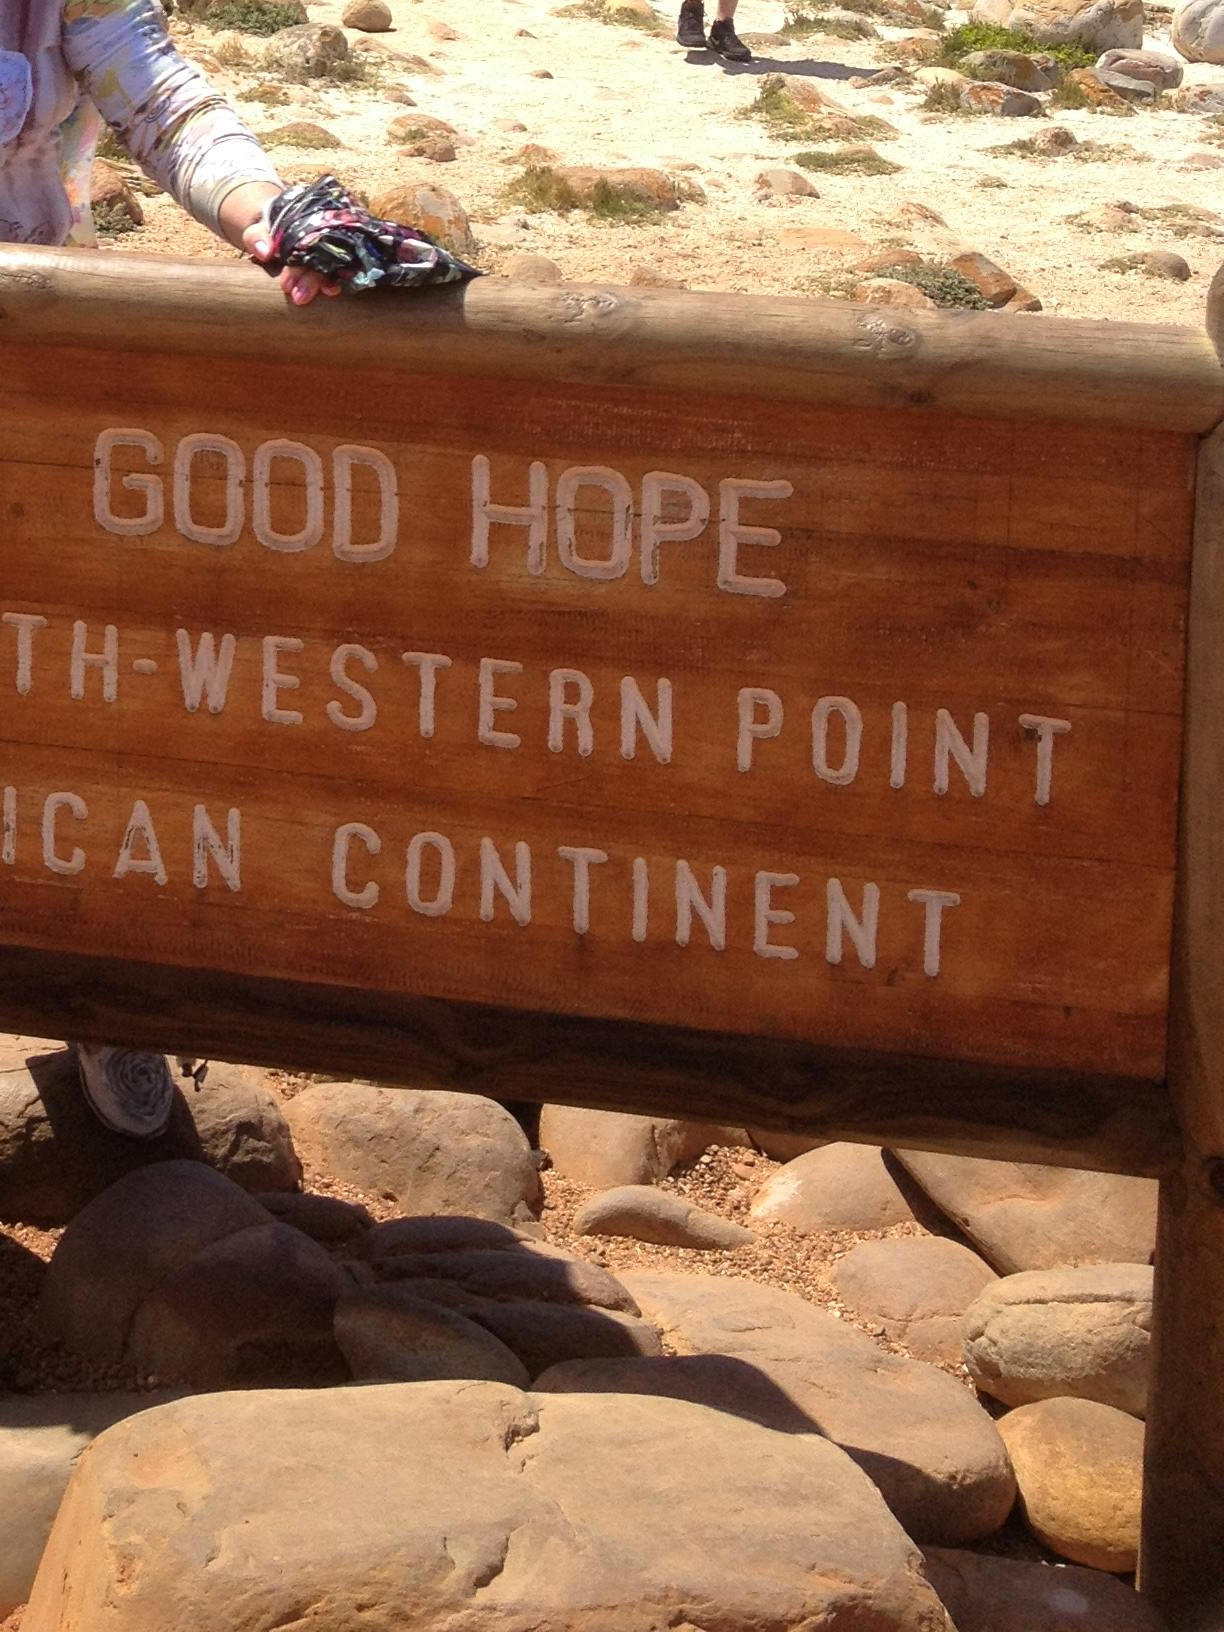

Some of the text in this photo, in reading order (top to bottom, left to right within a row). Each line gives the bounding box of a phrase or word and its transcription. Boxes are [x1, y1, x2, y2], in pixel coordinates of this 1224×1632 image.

[92, 427, 399, 563] GOOD
[470, 453, 794, 599] HOPE
[735, 685, 1073, 806] POINT
[331, 821, 962, 977] CONTINENT
